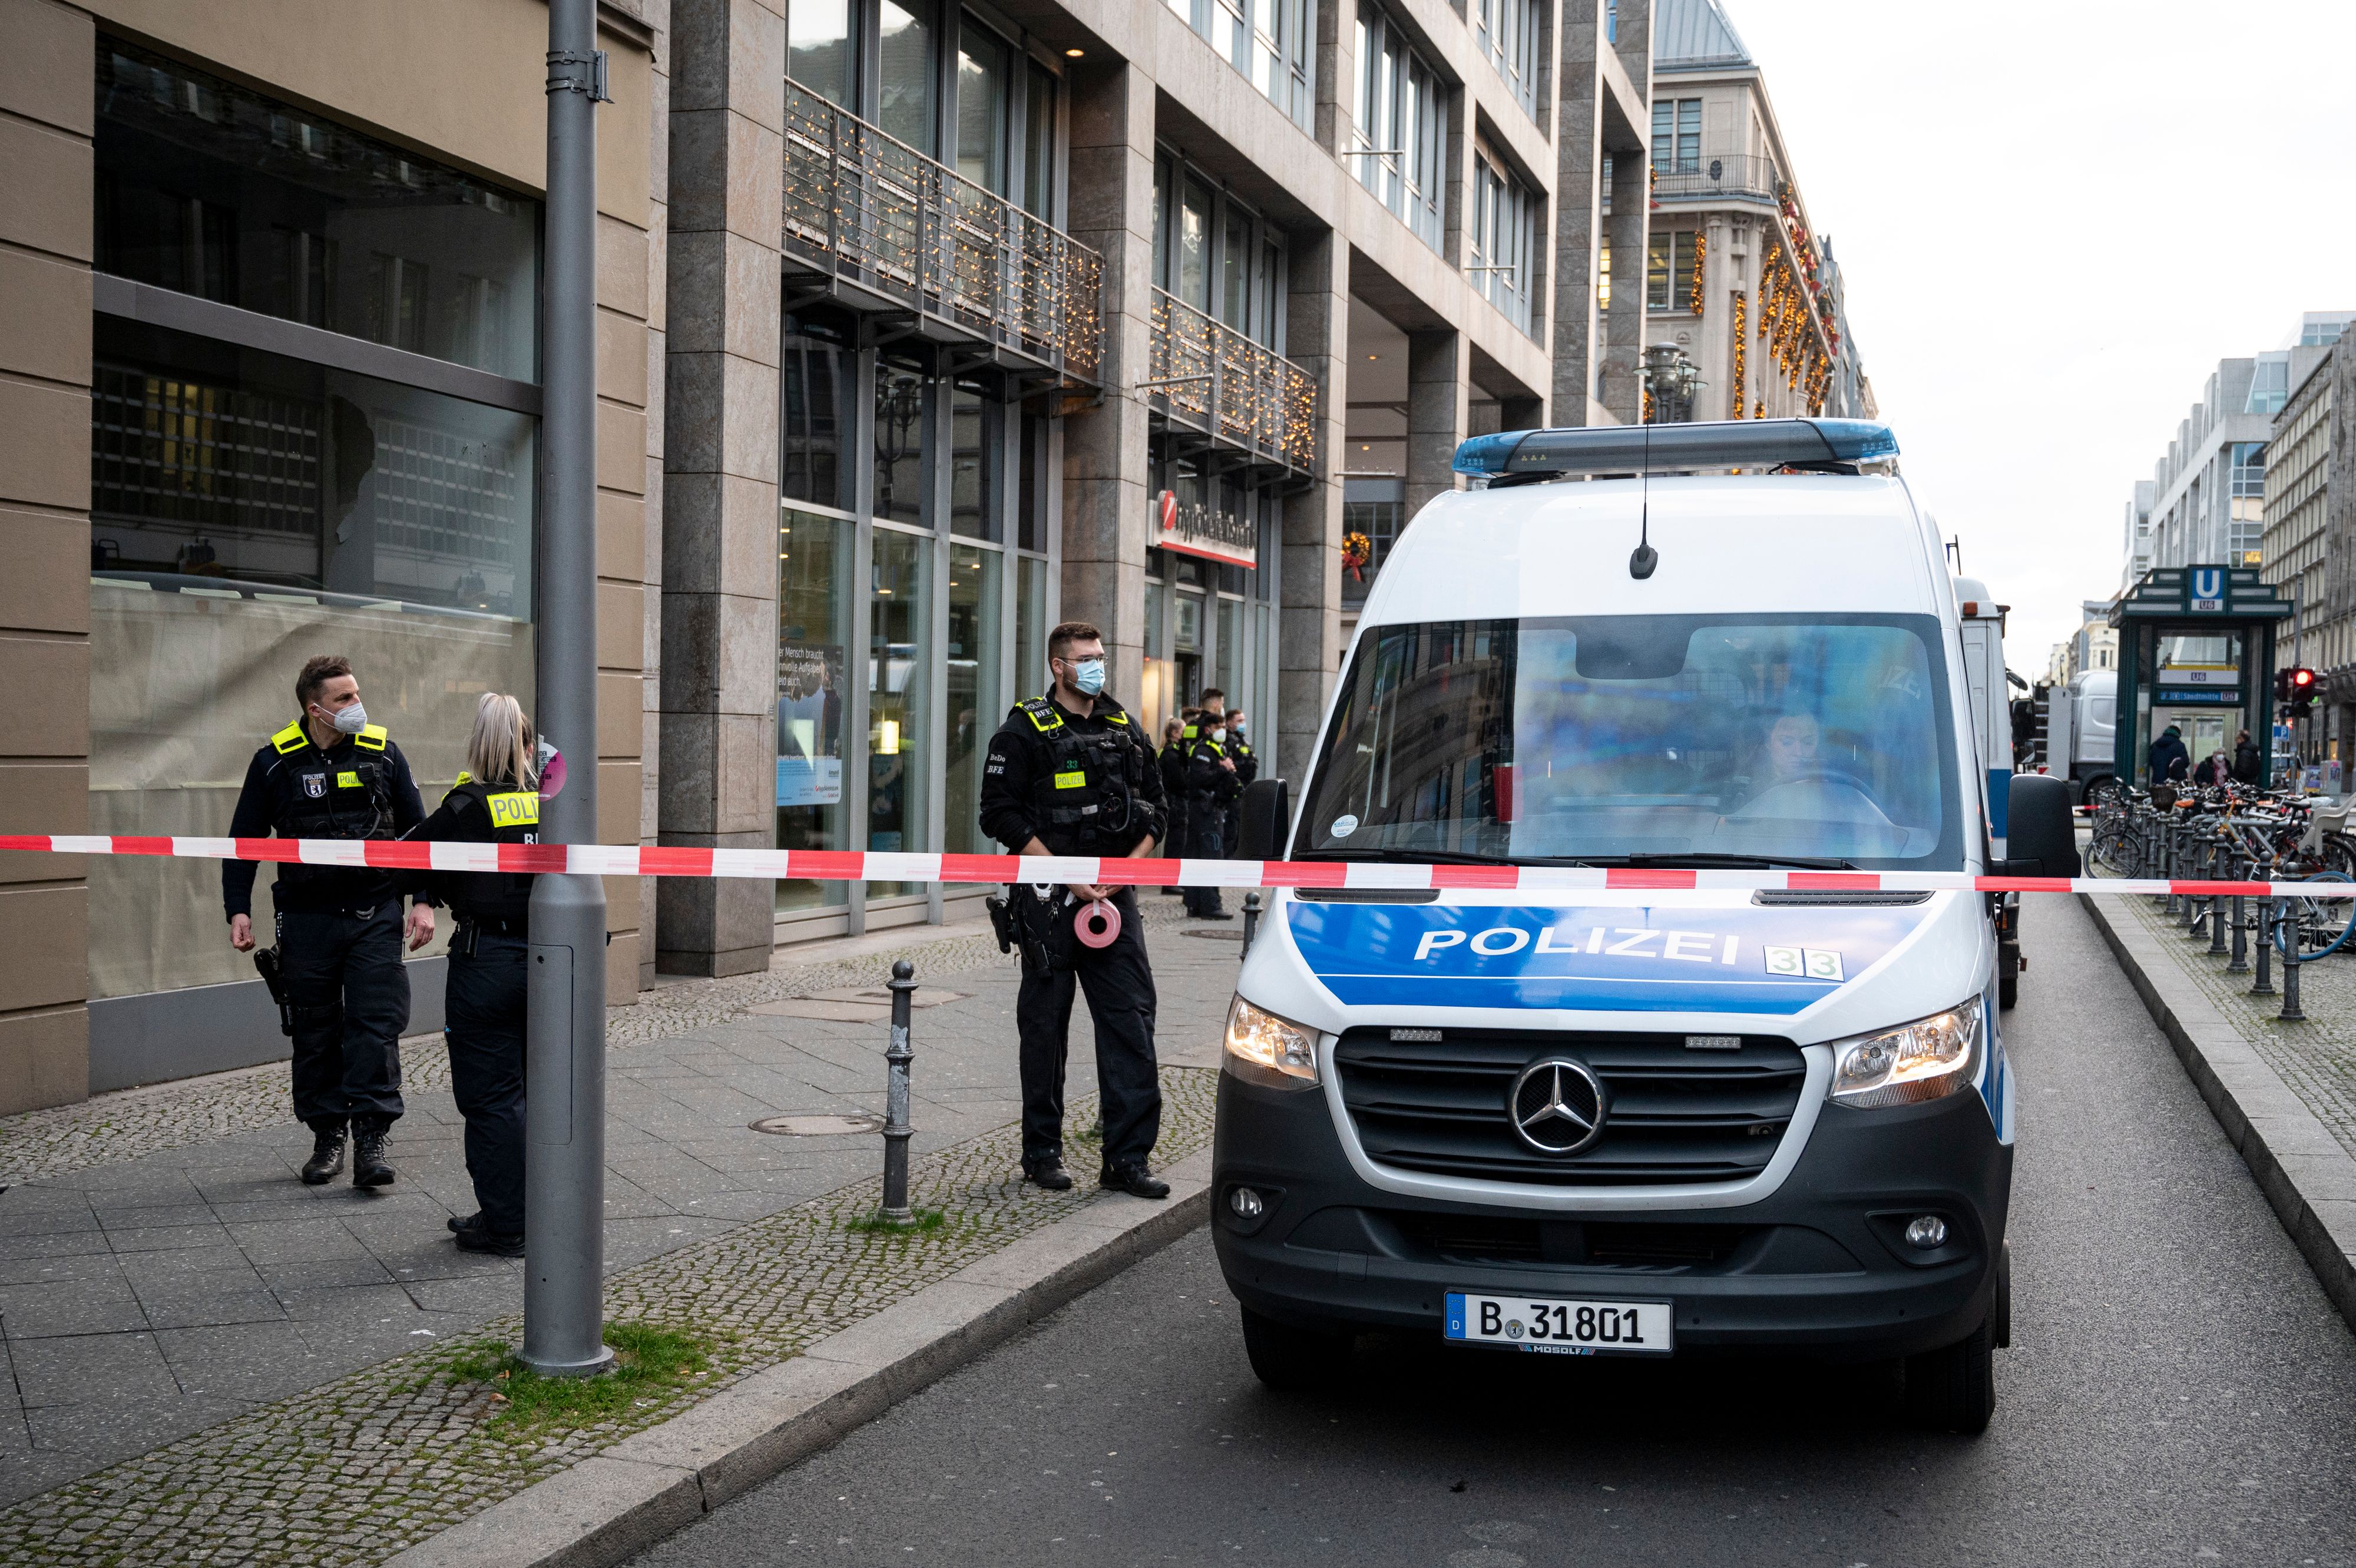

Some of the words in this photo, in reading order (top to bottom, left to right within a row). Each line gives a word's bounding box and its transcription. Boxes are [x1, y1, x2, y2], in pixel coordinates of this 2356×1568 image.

[2196, 570, 2221, 598] U
[2201, 601, 2215, 610] U6
[785, 647, 805, 659] Mensch
[805, 648, 824, 660] braucht
[787, 674, 801, 687] auch.
[2192, 672, 2205, 681] U6
[2183, 692, 2219, 700] Stadtmitte
[1035, 708, 1053, 718] BFE
[2281, 726, 2287, 735] P
[990, 753, 1006, 762] BeDo
[987, 765, 1004, 774] BFE
[1067, 760, 1078, 769] 33
[1057, 775, 1083, 786] POLIZEI
[494, 796, 538, 822] POLI
[1414, 927, 1739, 965] POLIZEI
[1772, 950, 1836, 976] 33
[1452, 1320, 1460, 1329] D
[1481, 1301, 1502, 1335] B
[1530, 1304, 1643, 1344] 31801
[1534, 1345, 1582, 1355] MOSOLF
